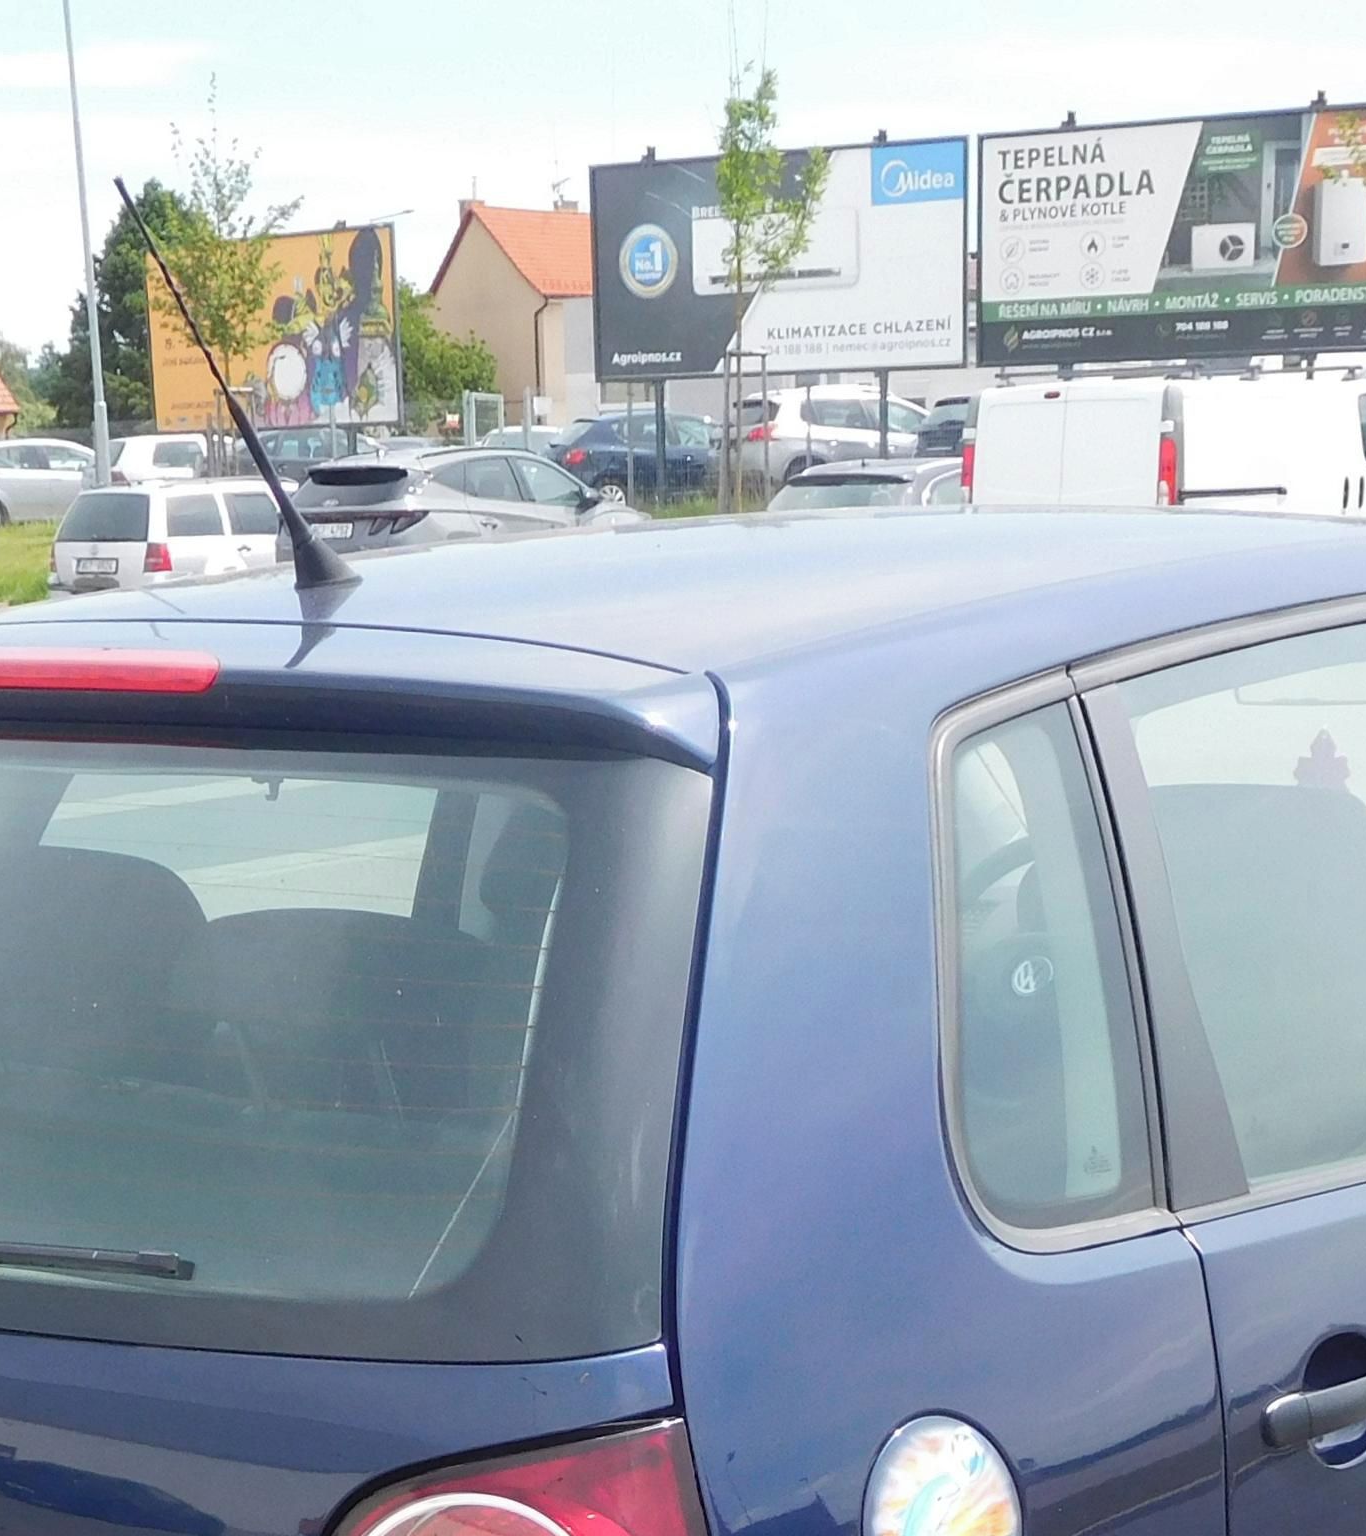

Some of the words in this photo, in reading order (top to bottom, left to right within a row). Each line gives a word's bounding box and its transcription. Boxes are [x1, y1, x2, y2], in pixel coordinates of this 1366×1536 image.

[998, 137, 1106, 171] TEPELNÁ
[880, 157, 956, 198] Midea
[998, 168, 1155, 206] ČERPADLA
[1013, 203, 1077, 222] PLYNOVÉ
[1081, 201, 1127, 217] KOTLE
[1040, 303, 1059, 316] NA
[1059, 298, 1092, 316] MÍRU
[1107, 295, 1149, 313] NÁVRH
[1165, 290, 1220, 311] MONTÁŽ
[1236, 293, 1278, 306] SERVIS
[767, 322, 867, 340] KLIMATIZACE
[873, 314, 952, 334] CHLAZENÍ
